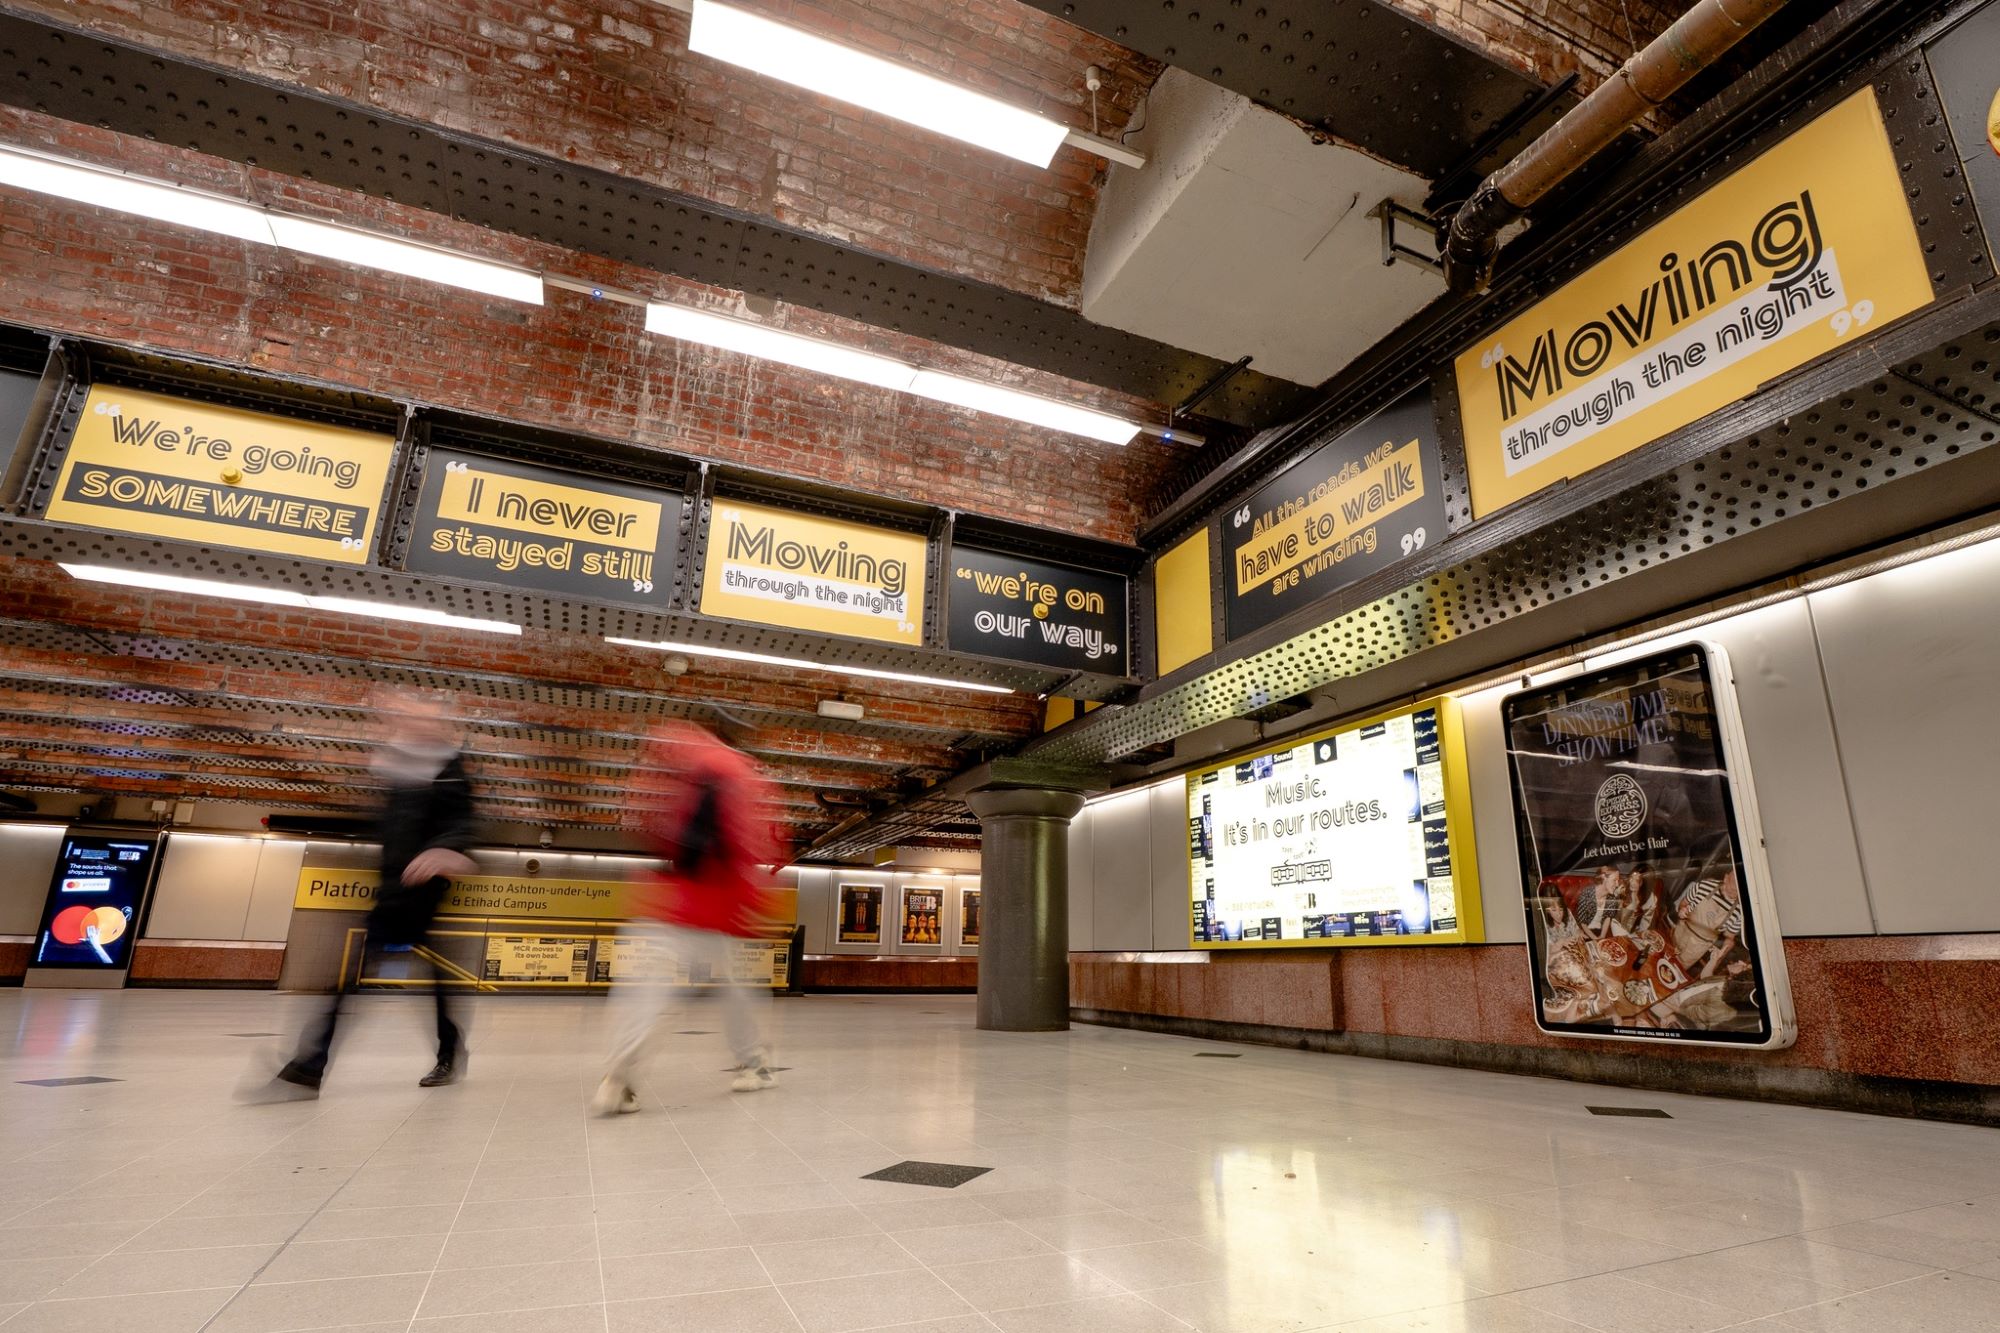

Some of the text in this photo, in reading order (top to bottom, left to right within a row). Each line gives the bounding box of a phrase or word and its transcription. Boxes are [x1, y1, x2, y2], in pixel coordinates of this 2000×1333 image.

[1505, 379, 1636, 462] through
[1641, 345, 1706, 390] the
[241, 441, 362, 490] going
[1278, 496, 1306, 526] the
[1307, 460, 1361, 510] roads
[1362, 437, 1394, 473] we
[496, 488, 637, 539] never
[1240, 458, 1416, 577] have to walk
[429, 525, 574, 578] stayed
[724, 568, 810, 600] through
[814, 583, 849, 605] the
[1272, 563, 1299, 597] are
[1064, 588, 1105, 615] on
[973, 610, 1031, 639] our
[1542, 688, 1678, 745] DINNERTIME.
[1273, 750, 1293, 763] Sound
[1265, 773, 1327, 809] Music.
[1600, 800, 1640, 816] EXPRESS
[1606, 793, 1629, 806] PIZZA
[1223, 820, 1249, 847] It's
[1253, 817, 1269, 842] in
[1272, 813, 1305, 838] our
[1310, 799, 1388, 832] routes.
[1583, 836, 1669, 859] Let there be flair
[451, 896, 548, 912] & Etihad Campus
[454, 880, 490, 893] Trams
[492, 882, 504, 893] to
[506, 883, 611, 898] Ashton-under-Lyne
[909, 895, 927, 904] BRIT
